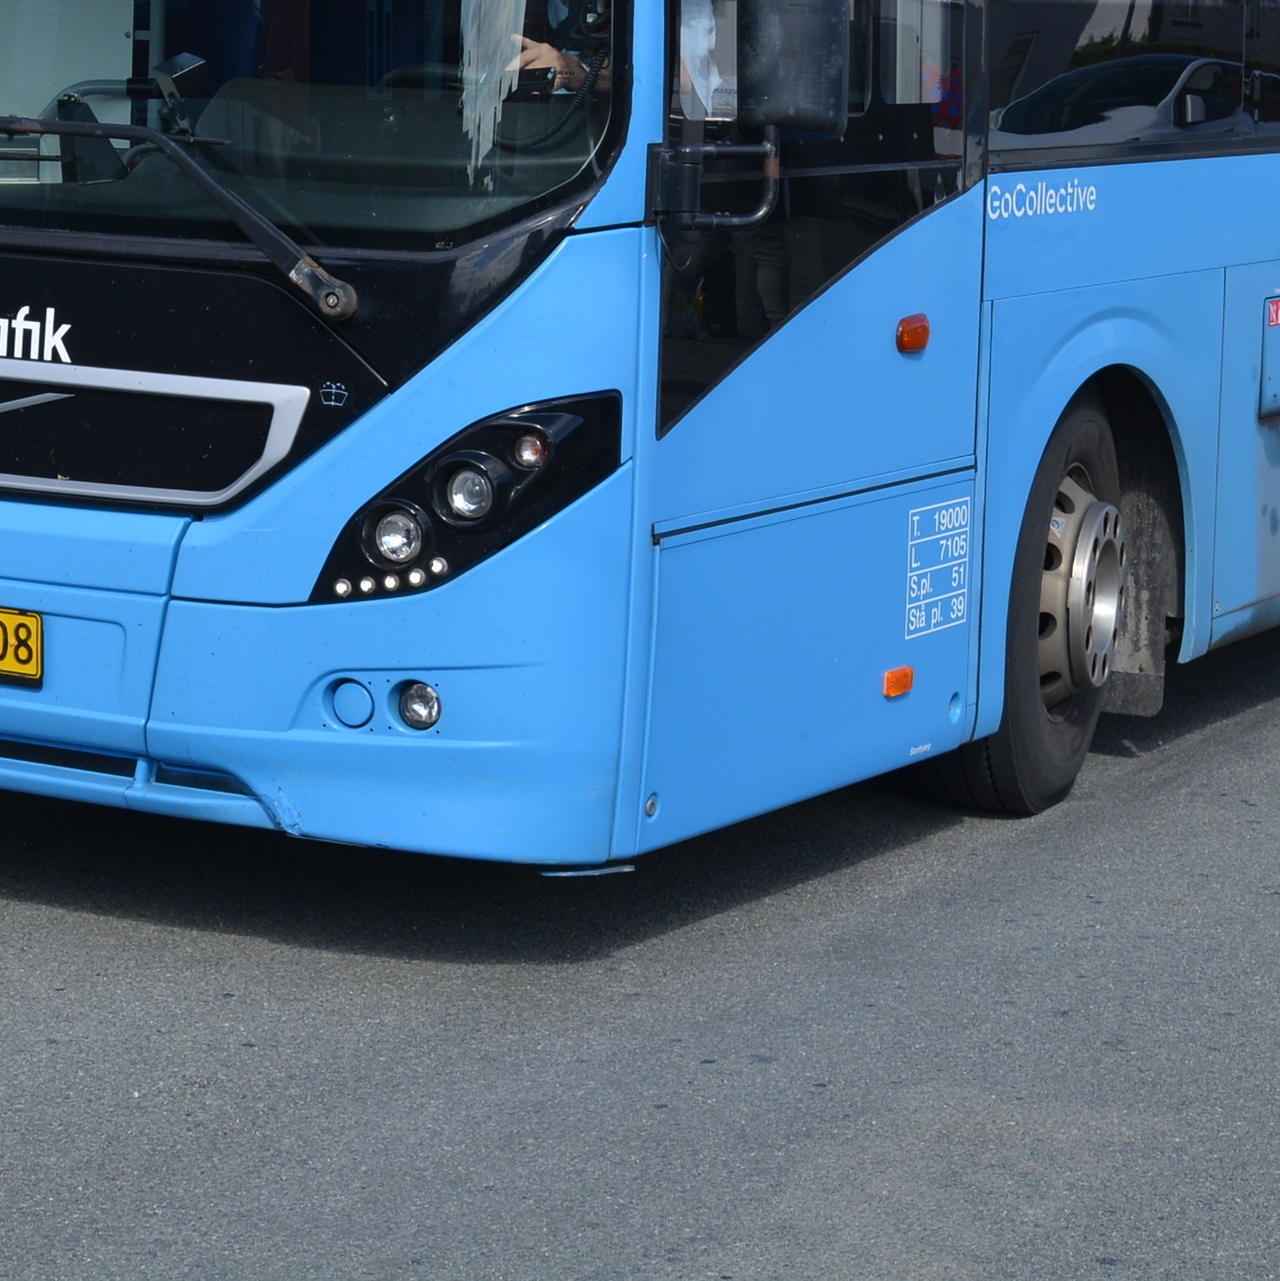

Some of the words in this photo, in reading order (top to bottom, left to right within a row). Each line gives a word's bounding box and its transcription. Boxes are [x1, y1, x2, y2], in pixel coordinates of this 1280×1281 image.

[986, 178, 1097, 220] GoCollective
[912, 515, 920, 537] T.
[934, 504, 968, 532] 19000
[911, 547, 920, 568] L.
[939, 535, 967, 560] 7105
[951, 564, 965, 587] 51
[908, 604, 926, 630] Stå
[930, 601, 943, 630] pl.
[950, 595, 964, 619] 39
